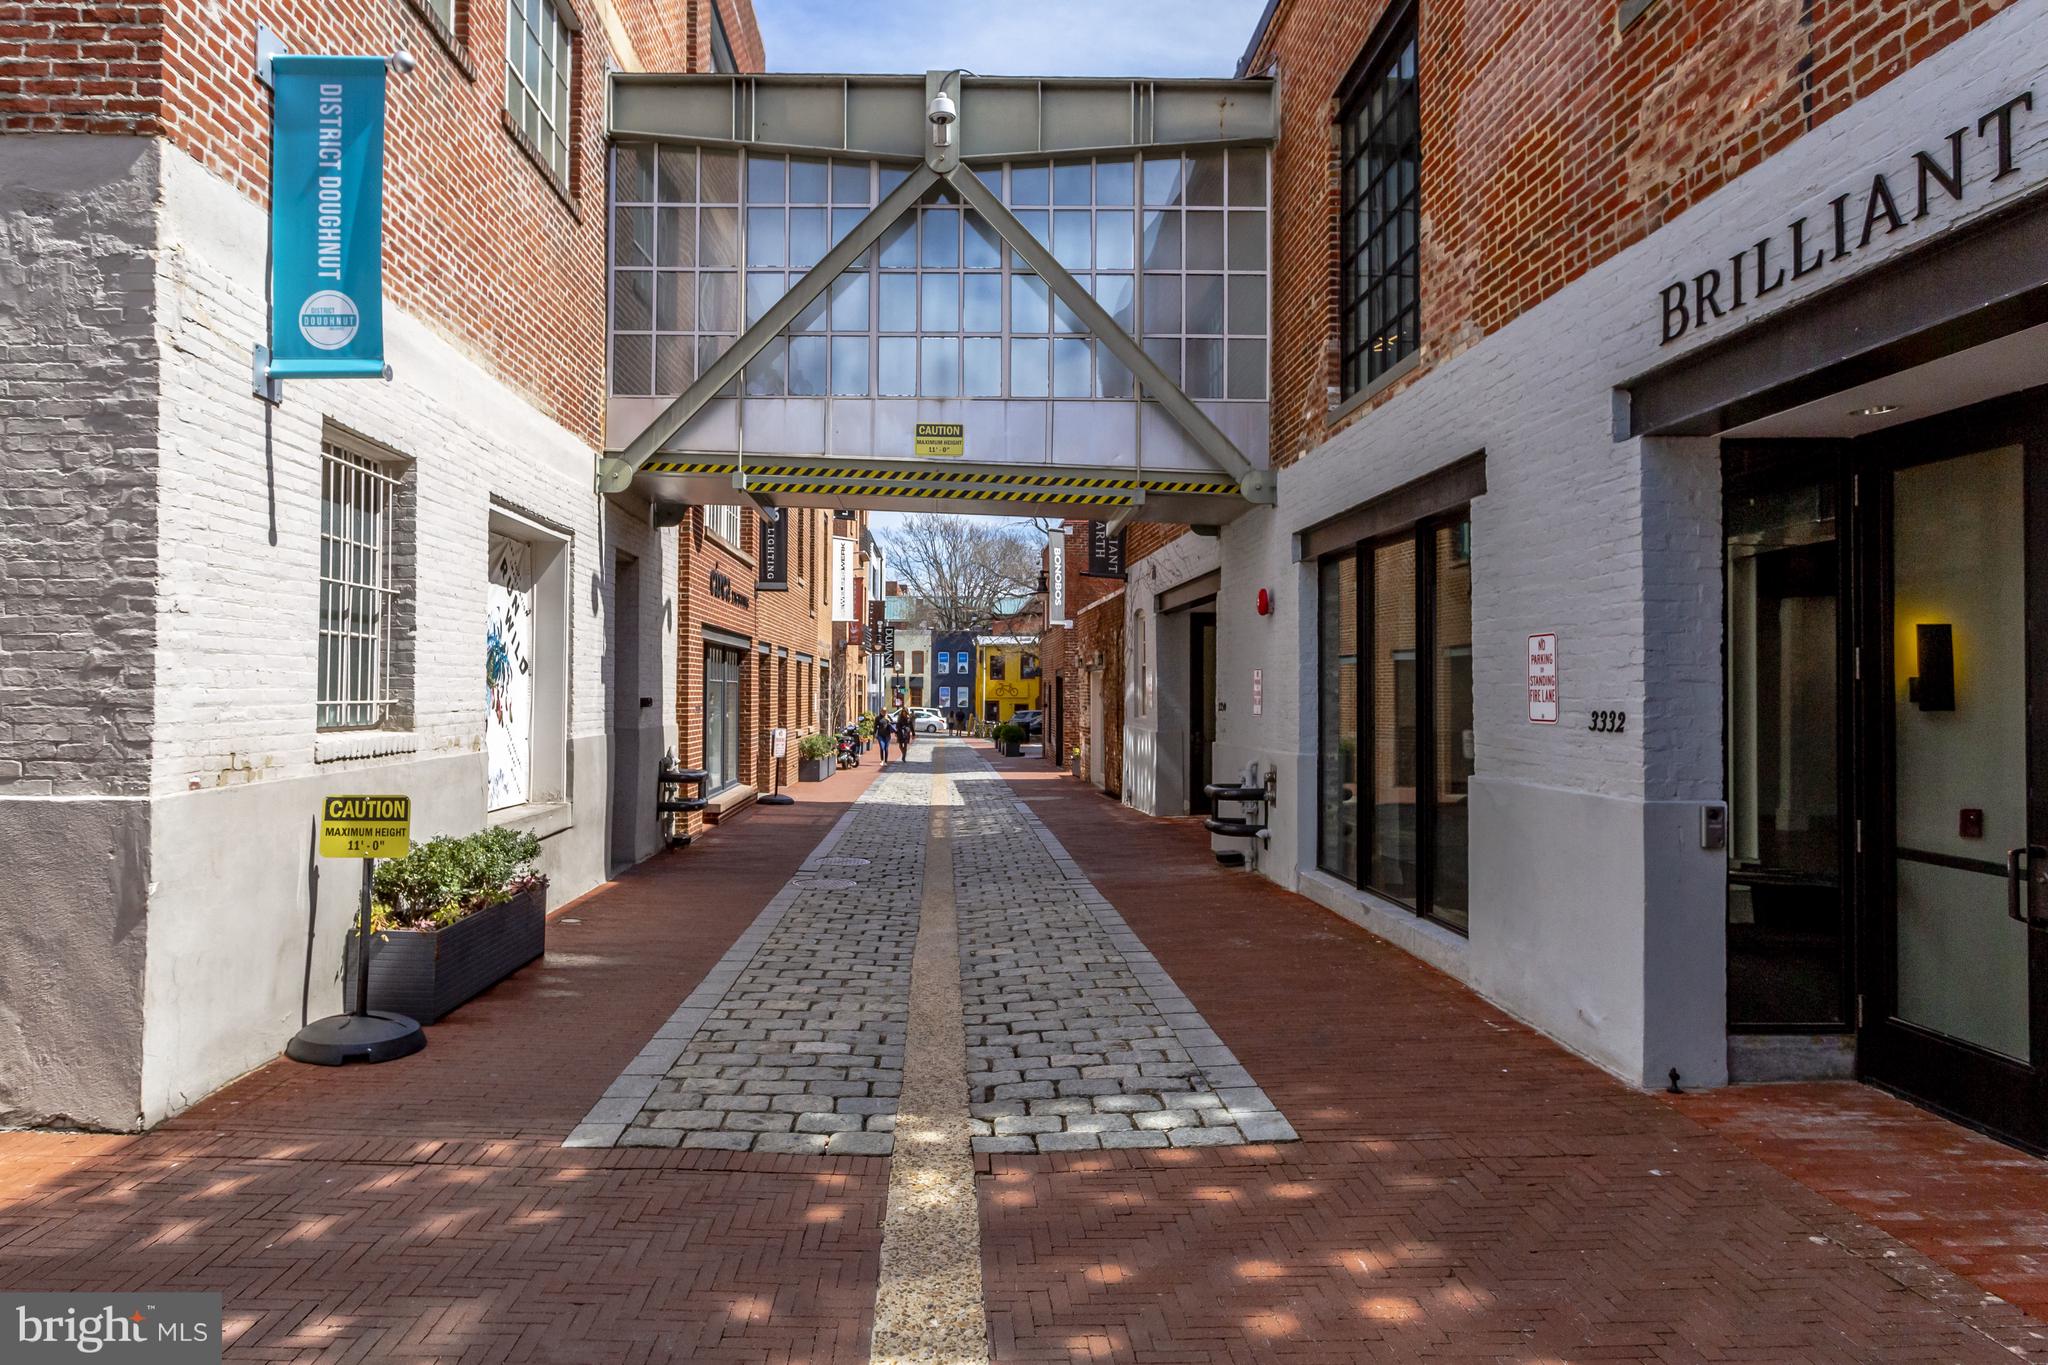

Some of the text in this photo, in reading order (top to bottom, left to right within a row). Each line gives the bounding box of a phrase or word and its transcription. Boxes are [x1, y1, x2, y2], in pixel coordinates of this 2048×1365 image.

[317, 84, 342, 281] DISTRICT DOUGHNUT
[1658, 91, 2034, 347] BRILLIANT
[304, 316, 355, 326] DOUGHNUT
[919, 425, 960, 435] CAUTION
[767, 528, 775, 580] LIGHTING
[1054, 547, 1062, 606] BONOBOS
[500, 557, 520, 617] RUN
[505, 607, 528, 675] WILD
[884, 628, 893, 666] DUXIANA
[1538, 639, 1545, 651] NO
[1531, 653, 1553, 665] PARKING
[1530, 675, 1555, 687] STANDING
[1529, 688, 1555, 703] FIRE LANE
[1588, 710, 1626, 733] 3332
[329, 800, 405, 818] CAUTION
[325, 827, 407, 837] MAXIMUM HEIGHT
